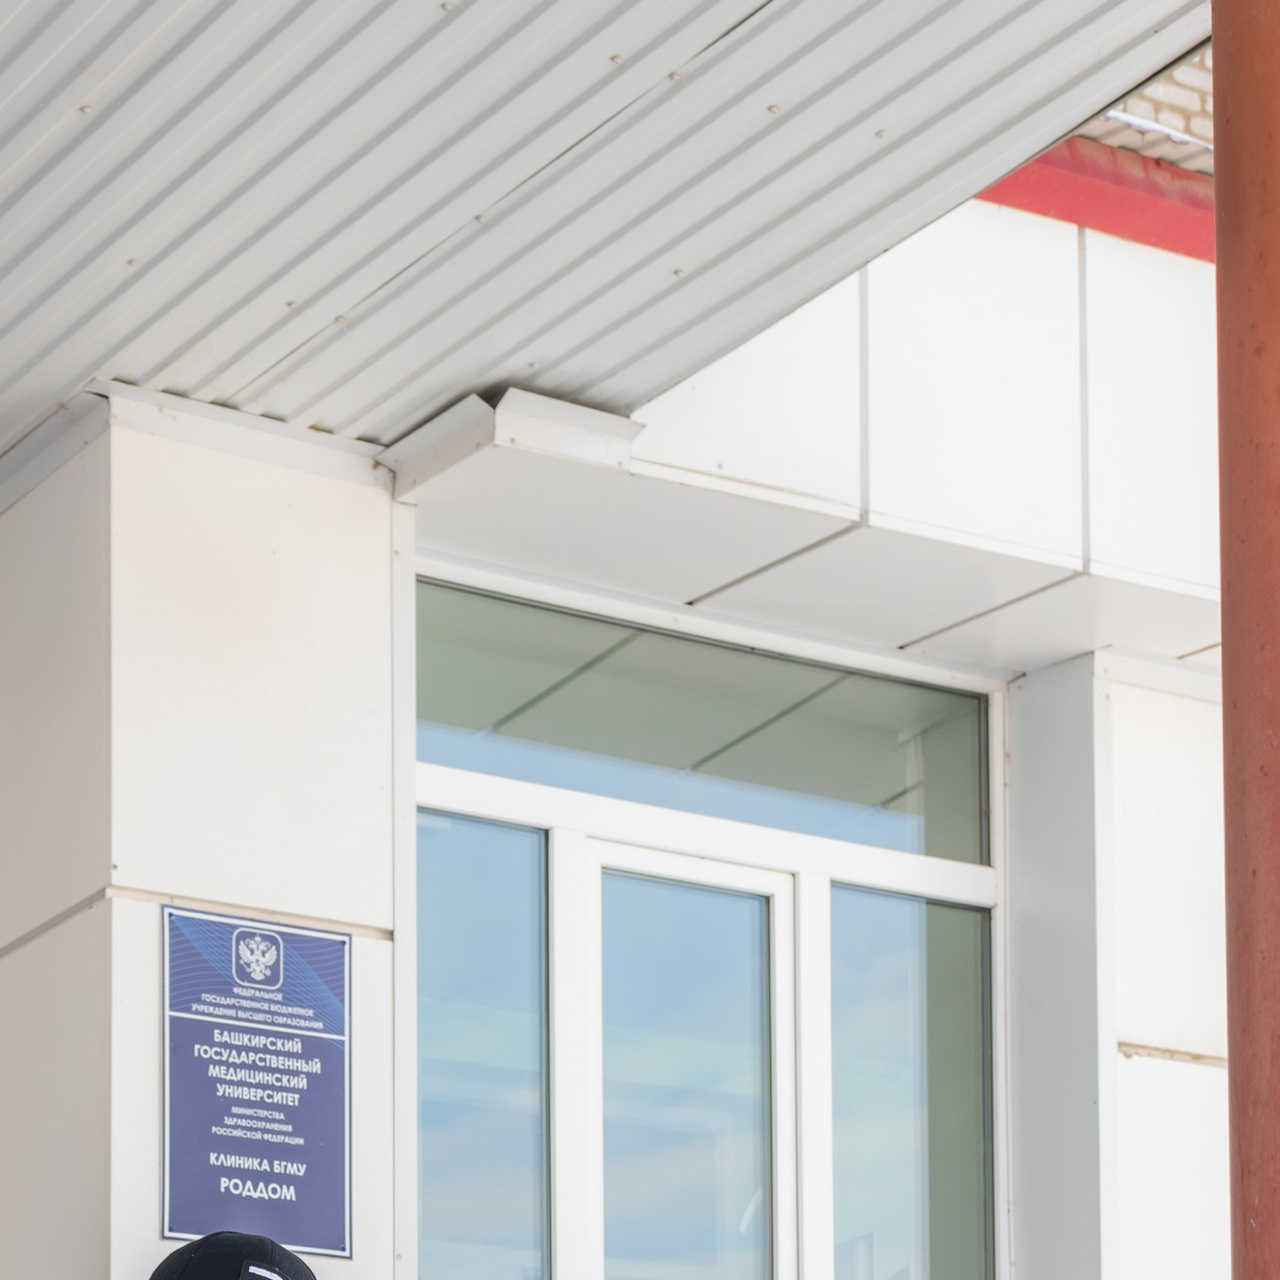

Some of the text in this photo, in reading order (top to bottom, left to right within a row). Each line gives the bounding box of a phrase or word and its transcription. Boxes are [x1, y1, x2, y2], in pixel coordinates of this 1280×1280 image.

[213, 1029, 302, 1053] БАШКИРСКИЙ
[194, 1044, 321, 1074] ГОСУДАРСТВЕННЫЙ
[208, 1064, 308, 1090] МЕДИЦИНСКИЙ
[216, 1083, 300, 1106] УНИВЕРСИТЕТ
[209, 1152, 307, 1176] КЛИНИКА БГМУ
[220, 1177, 296, 1201] РОДДОМ
